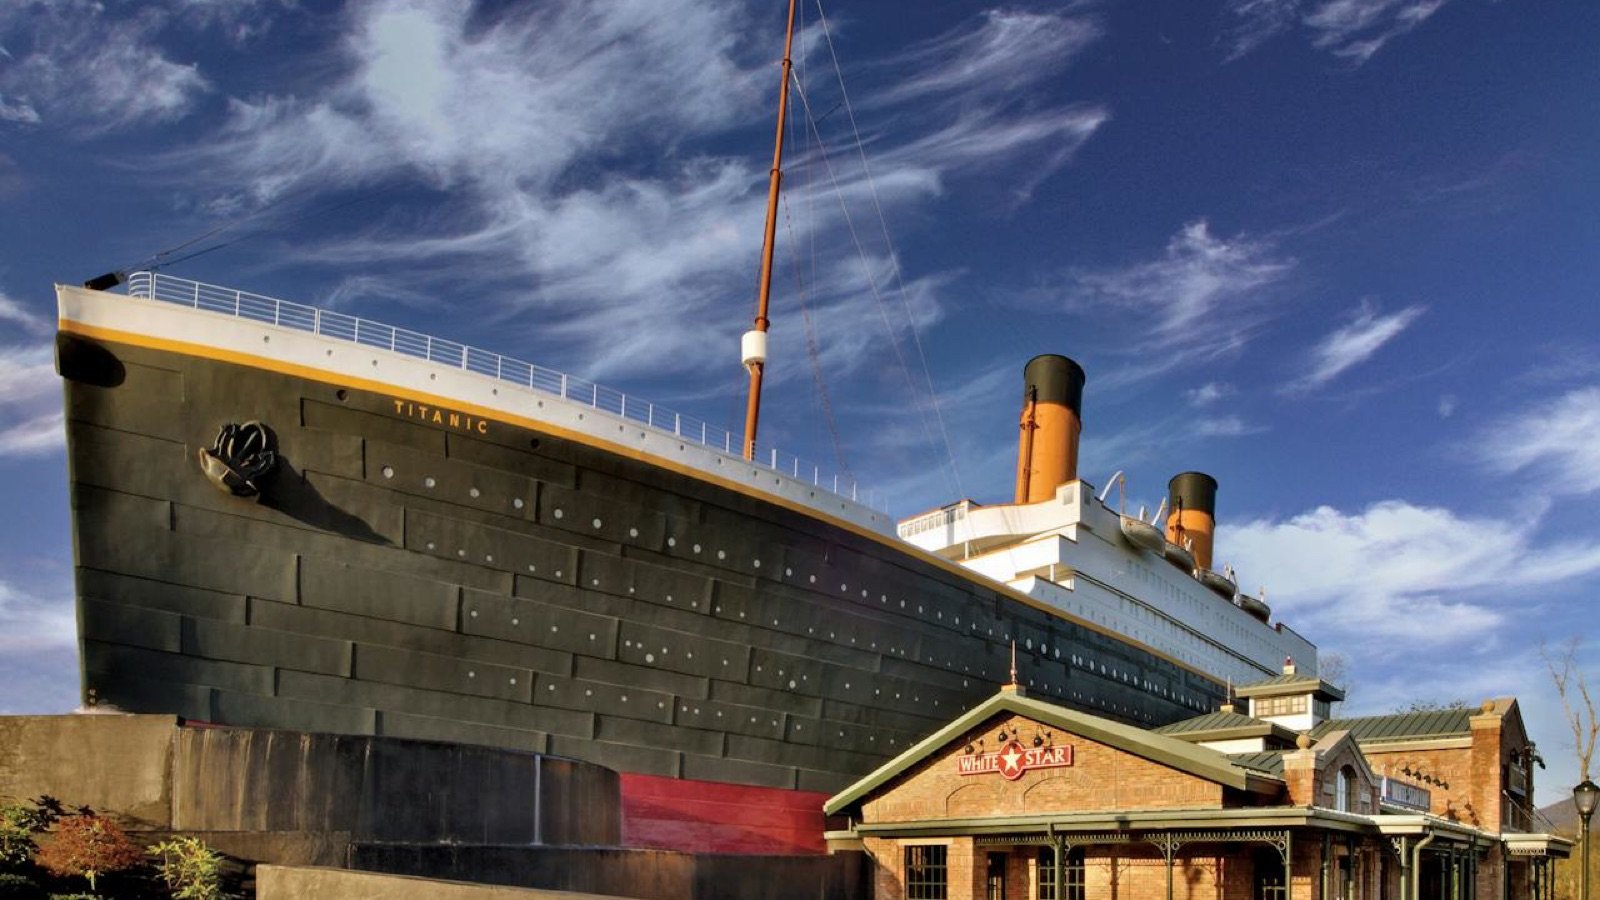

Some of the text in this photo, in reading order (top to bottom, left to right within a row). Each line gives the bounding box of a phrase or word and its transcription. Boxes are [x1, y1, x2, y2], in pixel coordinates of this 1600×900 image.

[394, 400, 487, 434] TITANIC
[960, 748, 1065, 771] WHITE STAR
